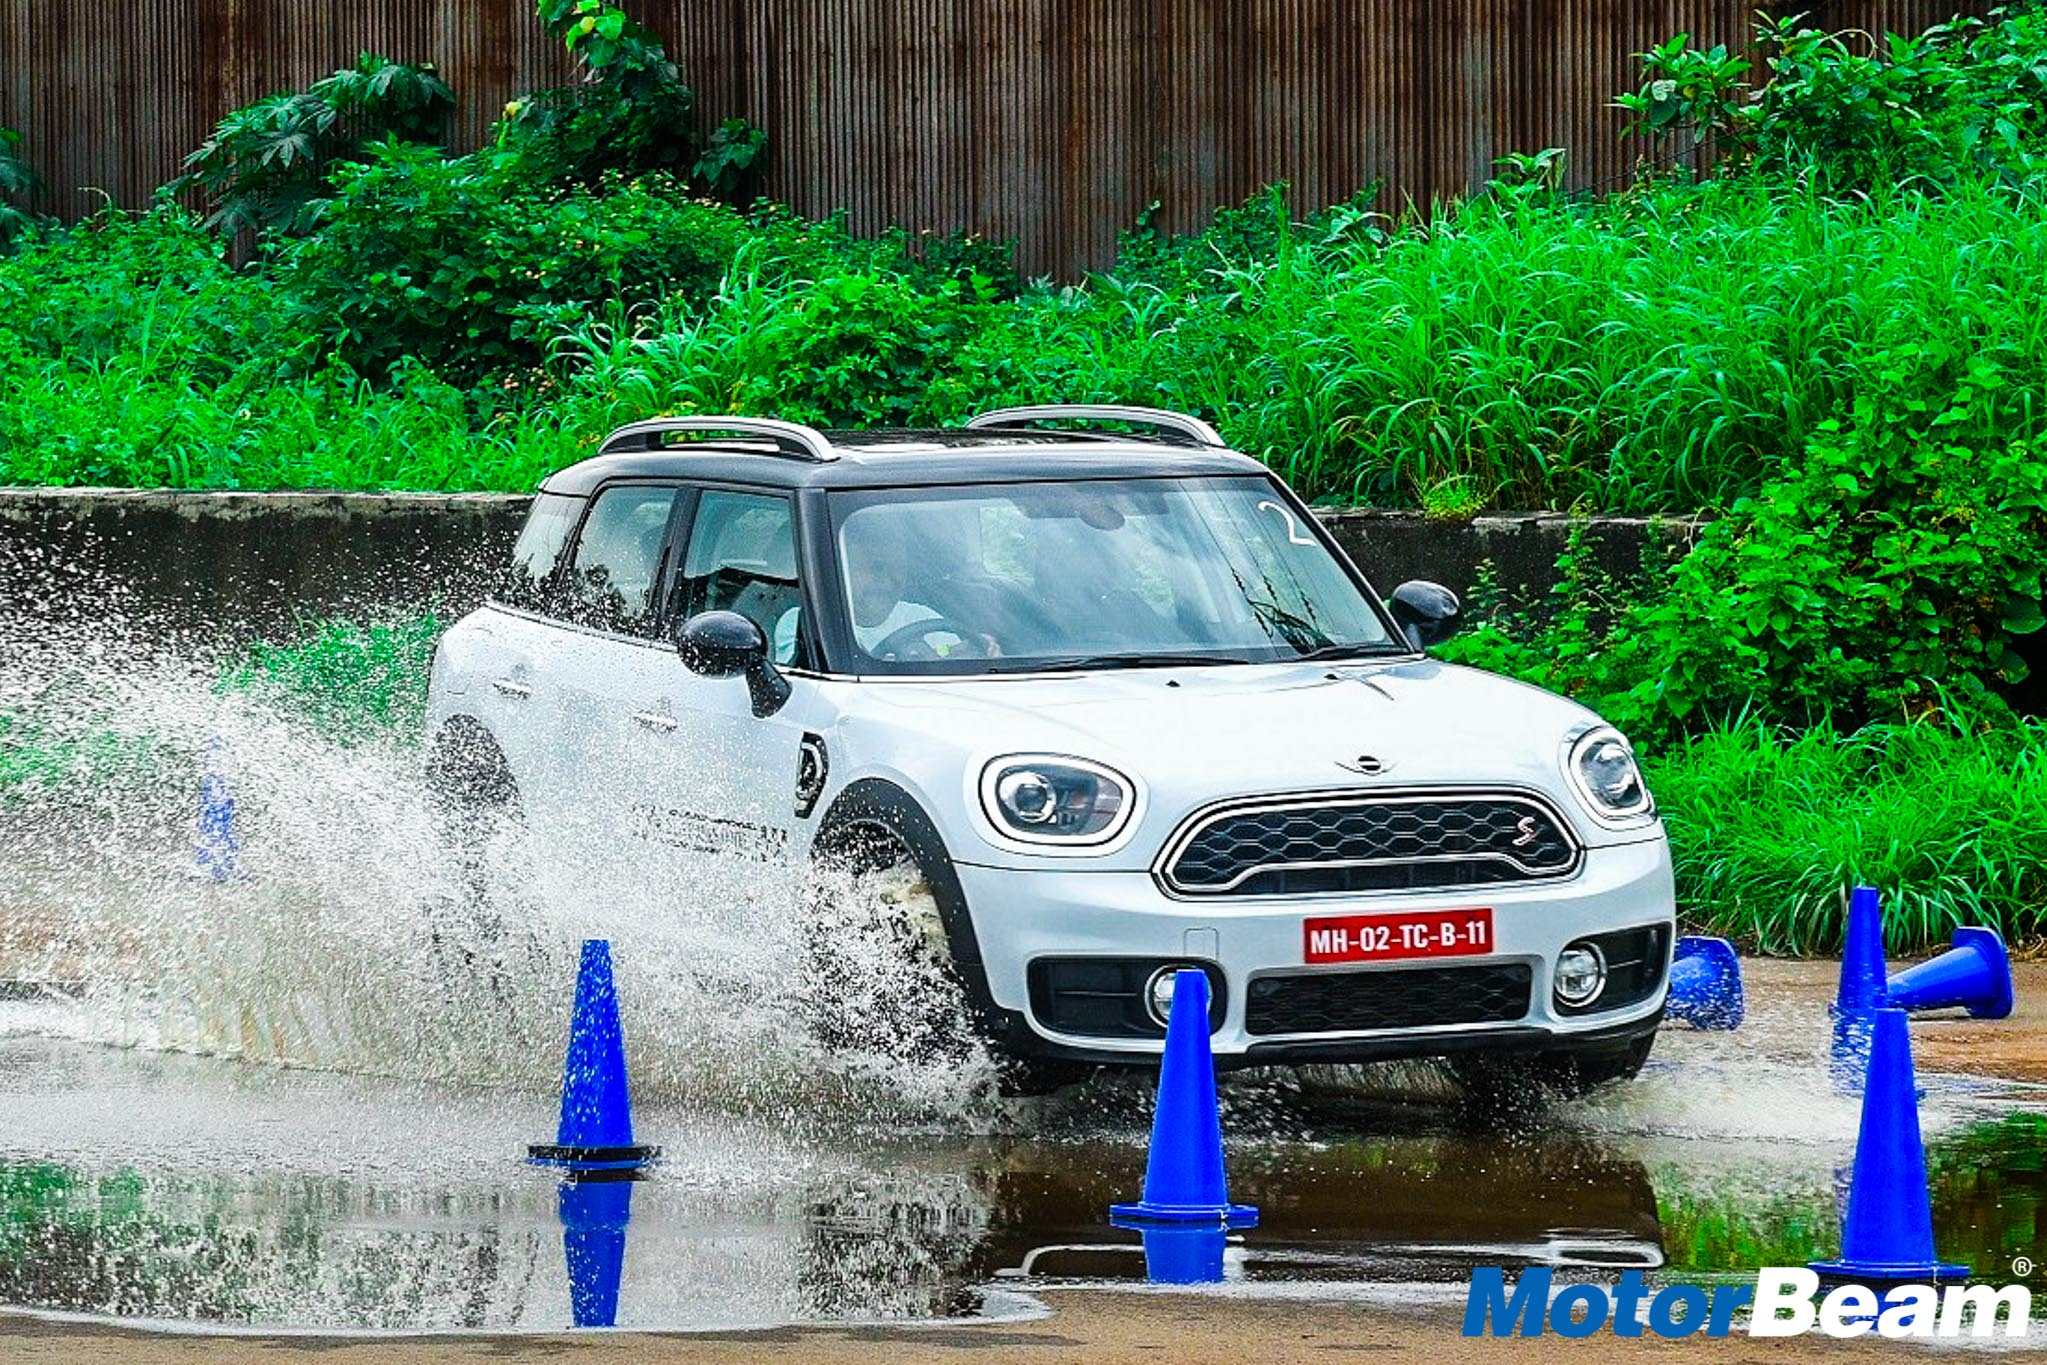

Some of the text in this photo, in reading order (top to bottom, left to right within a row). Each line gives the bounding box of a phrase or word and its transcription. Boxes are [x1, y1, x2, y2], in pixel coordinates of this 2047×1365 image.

[1258, 501, 1317, 547] 2
[1512, 816, 1536, 846] S
[1310, 921, 1486, 954] MH-02-TC-B-11
